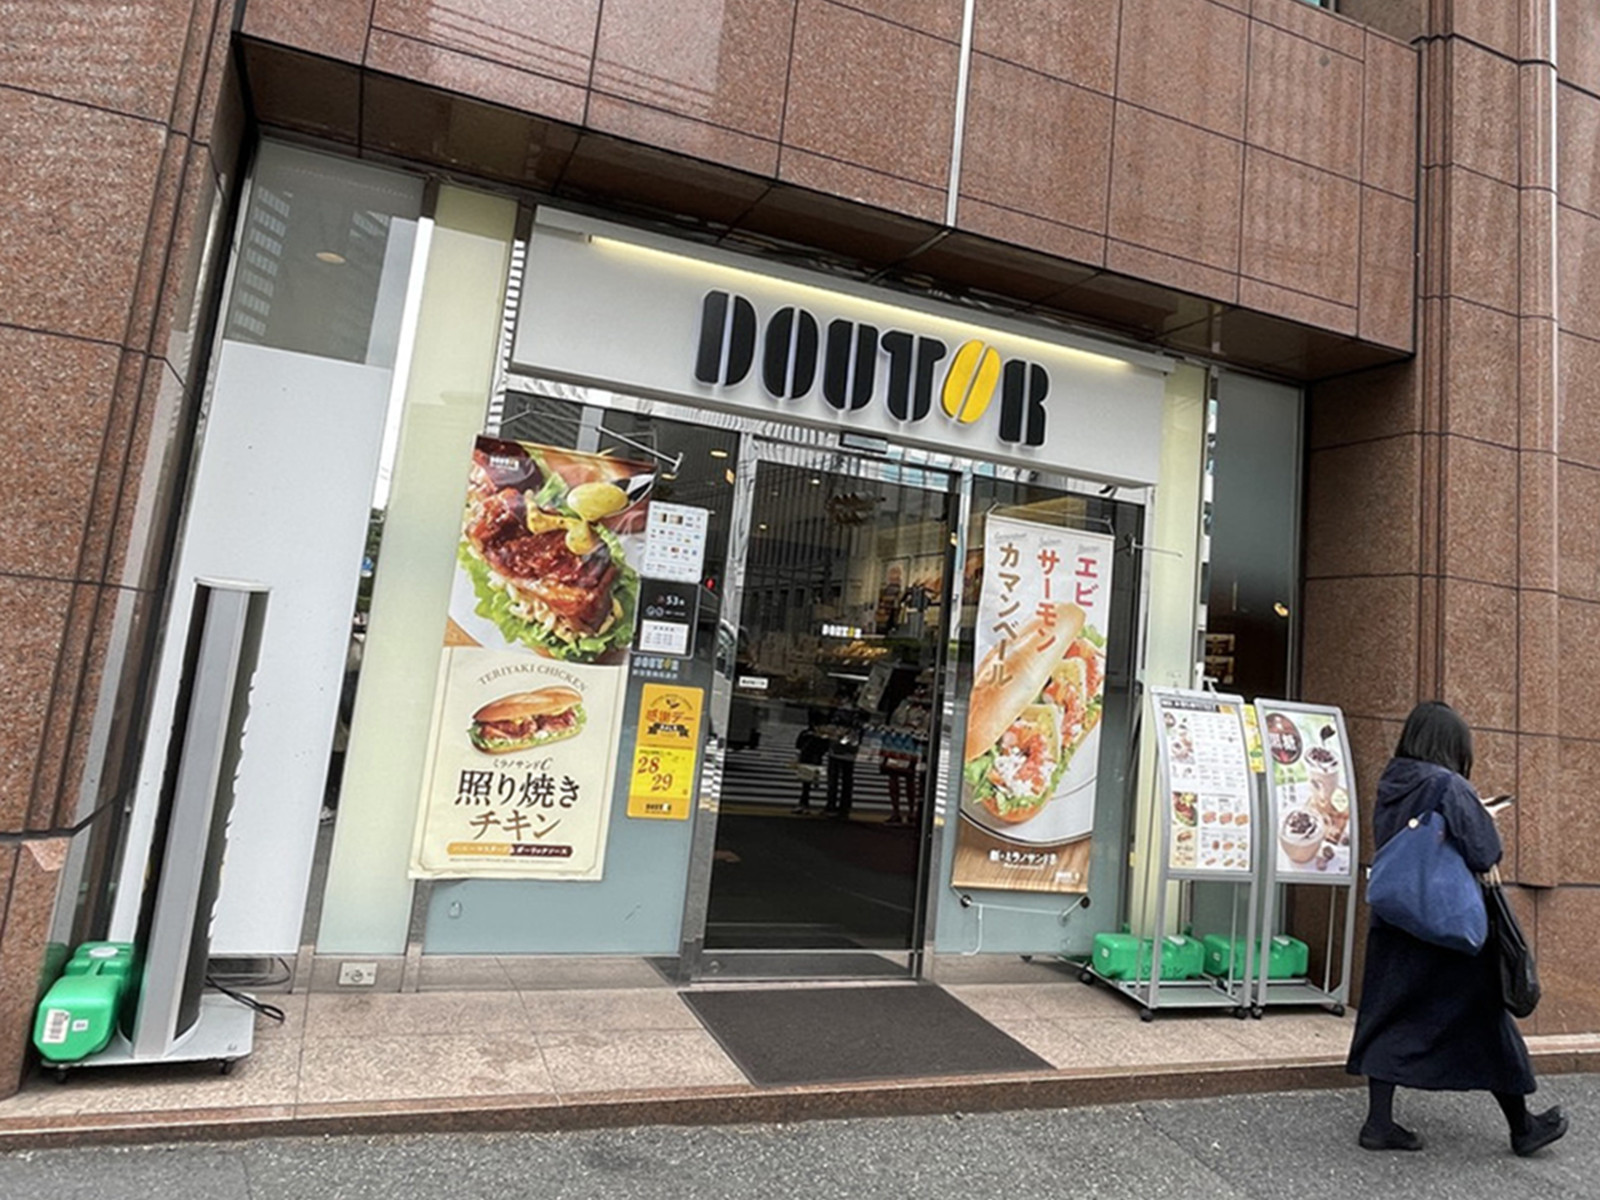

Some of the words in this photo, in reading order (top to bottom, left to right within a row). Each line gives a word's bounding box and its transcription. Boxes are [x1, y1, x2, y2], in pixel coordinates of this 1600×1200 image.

[694, 289, 1050, 448] DOUTOR
[1036, 550, 1060, 652] サーモン
[1075, 557, 1099, 607] エビ
[984, 543, 1021, 686] カマンベール
[478, 664, 535, 686] TERIYAKI
[537, 665, 588, 692] CHICKEN
[637, 757, 661, 775] 28
[651, 773, 674, 792] 29
[455, 769, 580, 809] 照り焼き
[469, 809, 562, 842] チキン
